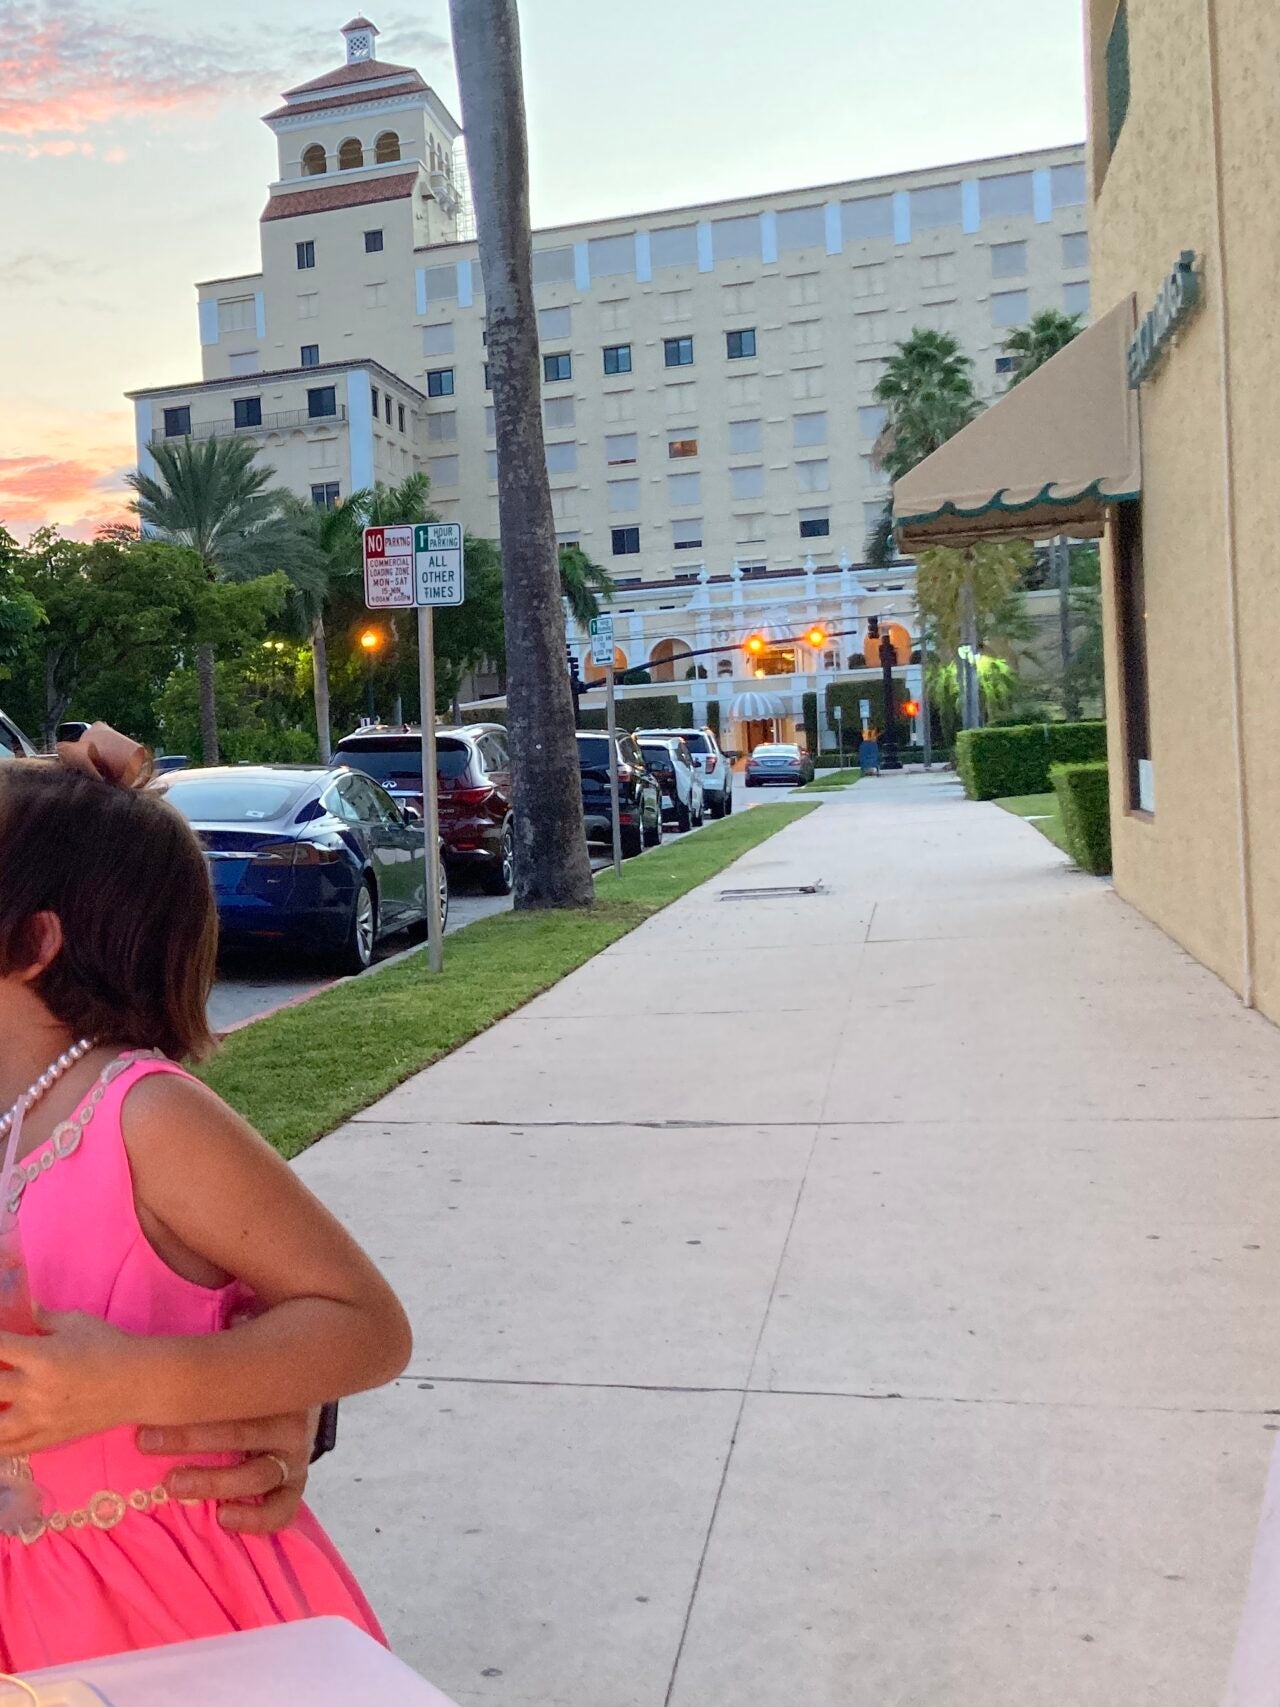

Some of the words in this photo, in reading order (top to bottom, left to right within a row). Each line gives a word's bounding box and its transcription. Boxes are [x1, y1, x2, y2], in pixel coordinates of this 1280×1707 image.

[433, 527, 453, 537] HOUR
[367, 534, 383, 553] NO
[385, 536, 410, 547] PARKING
[429, 537, 458, 548] PARKING
[370, 558, 410, 568] COMMERCIAL
[429, 555, 448, 568] ALL
[370, 568, 393, 577] LOADING
[395, 567, 410, 576] ZONE
[421, 570, 455, 583] OTHER
[423, 586, 454, 599] TIMES
